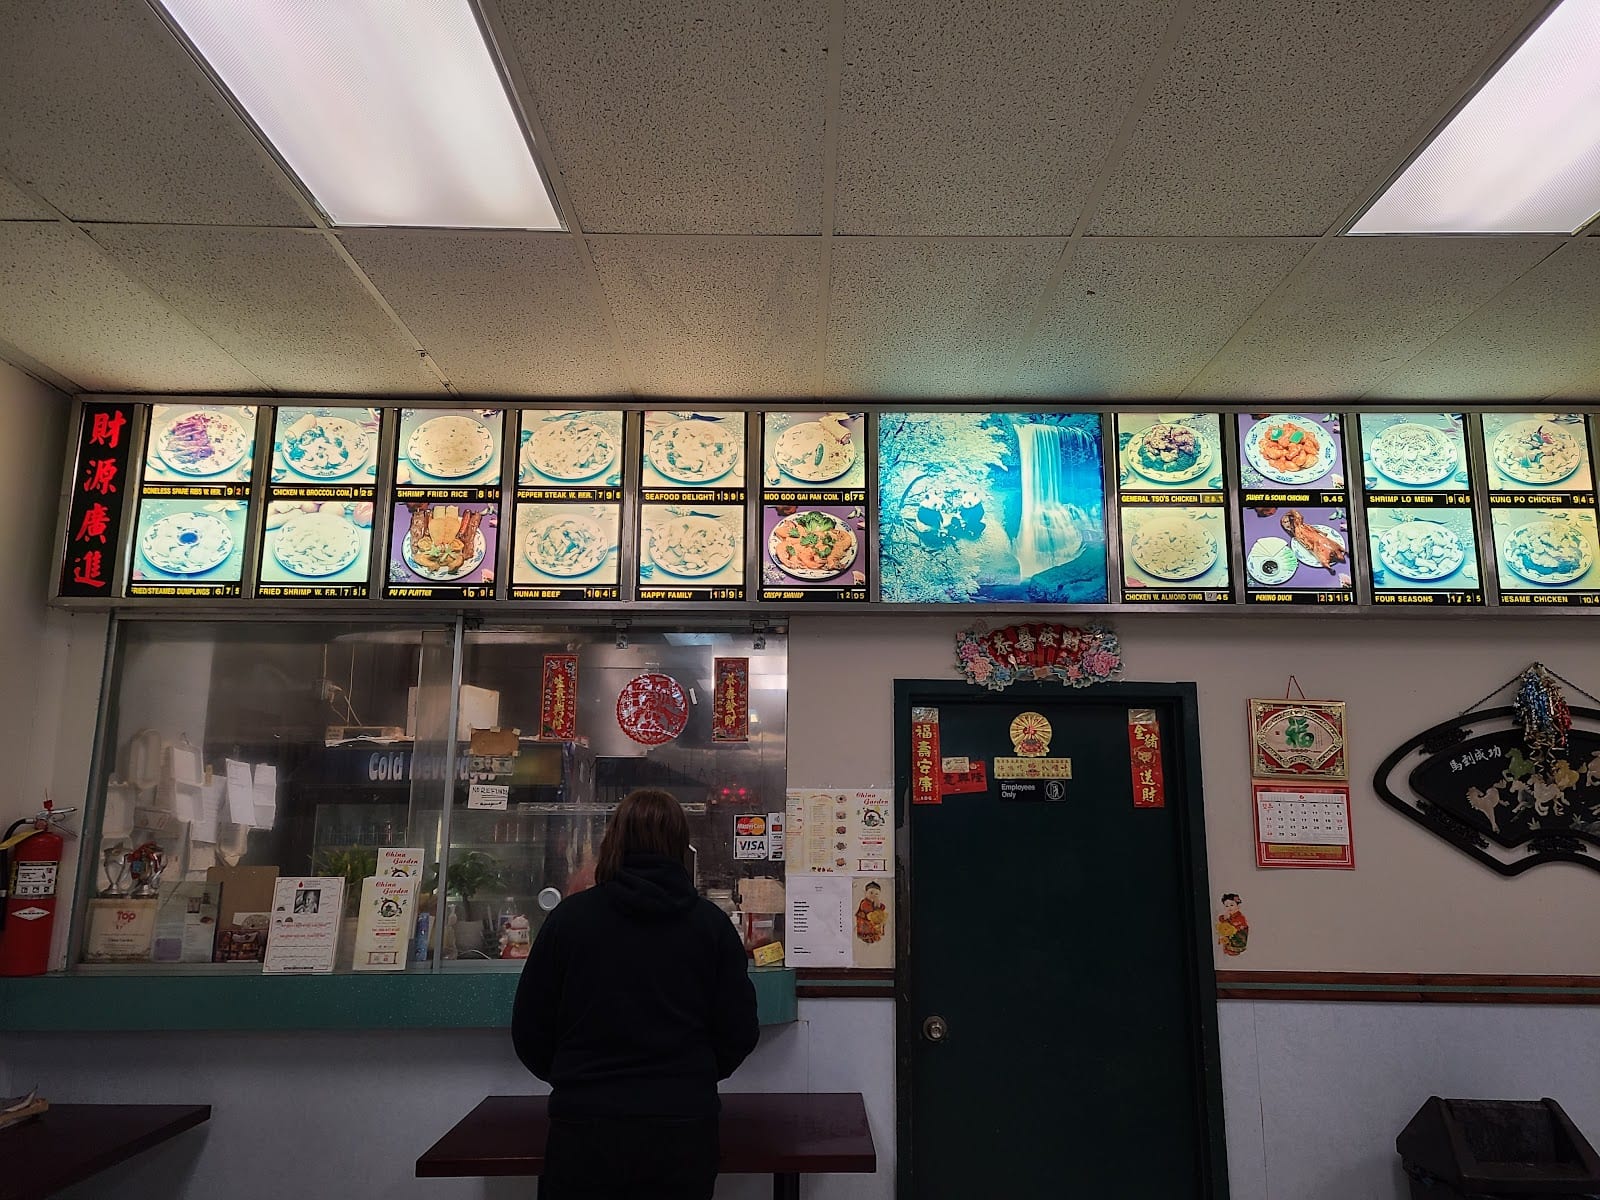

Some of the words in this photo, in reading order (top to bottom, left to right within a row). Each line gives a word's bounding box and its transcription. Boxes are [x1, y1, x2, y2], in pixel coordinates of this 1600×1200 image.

[272, 488, 298, 497] CHICKEN
[306, 488, 335, 497] BROCCOLI
[398, 490, 425, 498] SHRIMP
[427, 490, 449, 498] FRIED
[450, 490, 468, 498] RICE
[517, 491, 544, 499] PEPPER
[544, 491, 568, 499] STEAK
[74, 410, 127, 588] 財源廣進
[644, 493, 680, 501] SEAFOOD
[682, 493, 714, 501] DELIGHT
[764, 493, 780, 501] MOO
[781, 493, 796, 501] GOO
[796, 493, 809, 501] GAI
[810, 493, 822, 501] PAN
[177, 587, 210, 596] DUMPLINGS
[258, 588, 282, 596] FRIED
[284, 588, 312, 596] SHRIMP
[641, 591, 666, 599] HAPPY
[668, 591, 693, 599] FAMILY
[1125, 593, 1152, 601] CHICKEN
[1161, 593, 1187, 601] ALMOND
[1188, 593, 1203, 601] DING
[915, 724, 933, 793] 福壽安康
[1449, 745, 1502, 773] 馬到成功
[368, 752, 404, 781] Cold
[1001, 783, 1035, 792] Employees
[740, 840, 765, 851] VISA
[392, 858, 418, 866] Garden
[382, 888, 409, 896] Garden
[116, 910, 136, 922] Top
